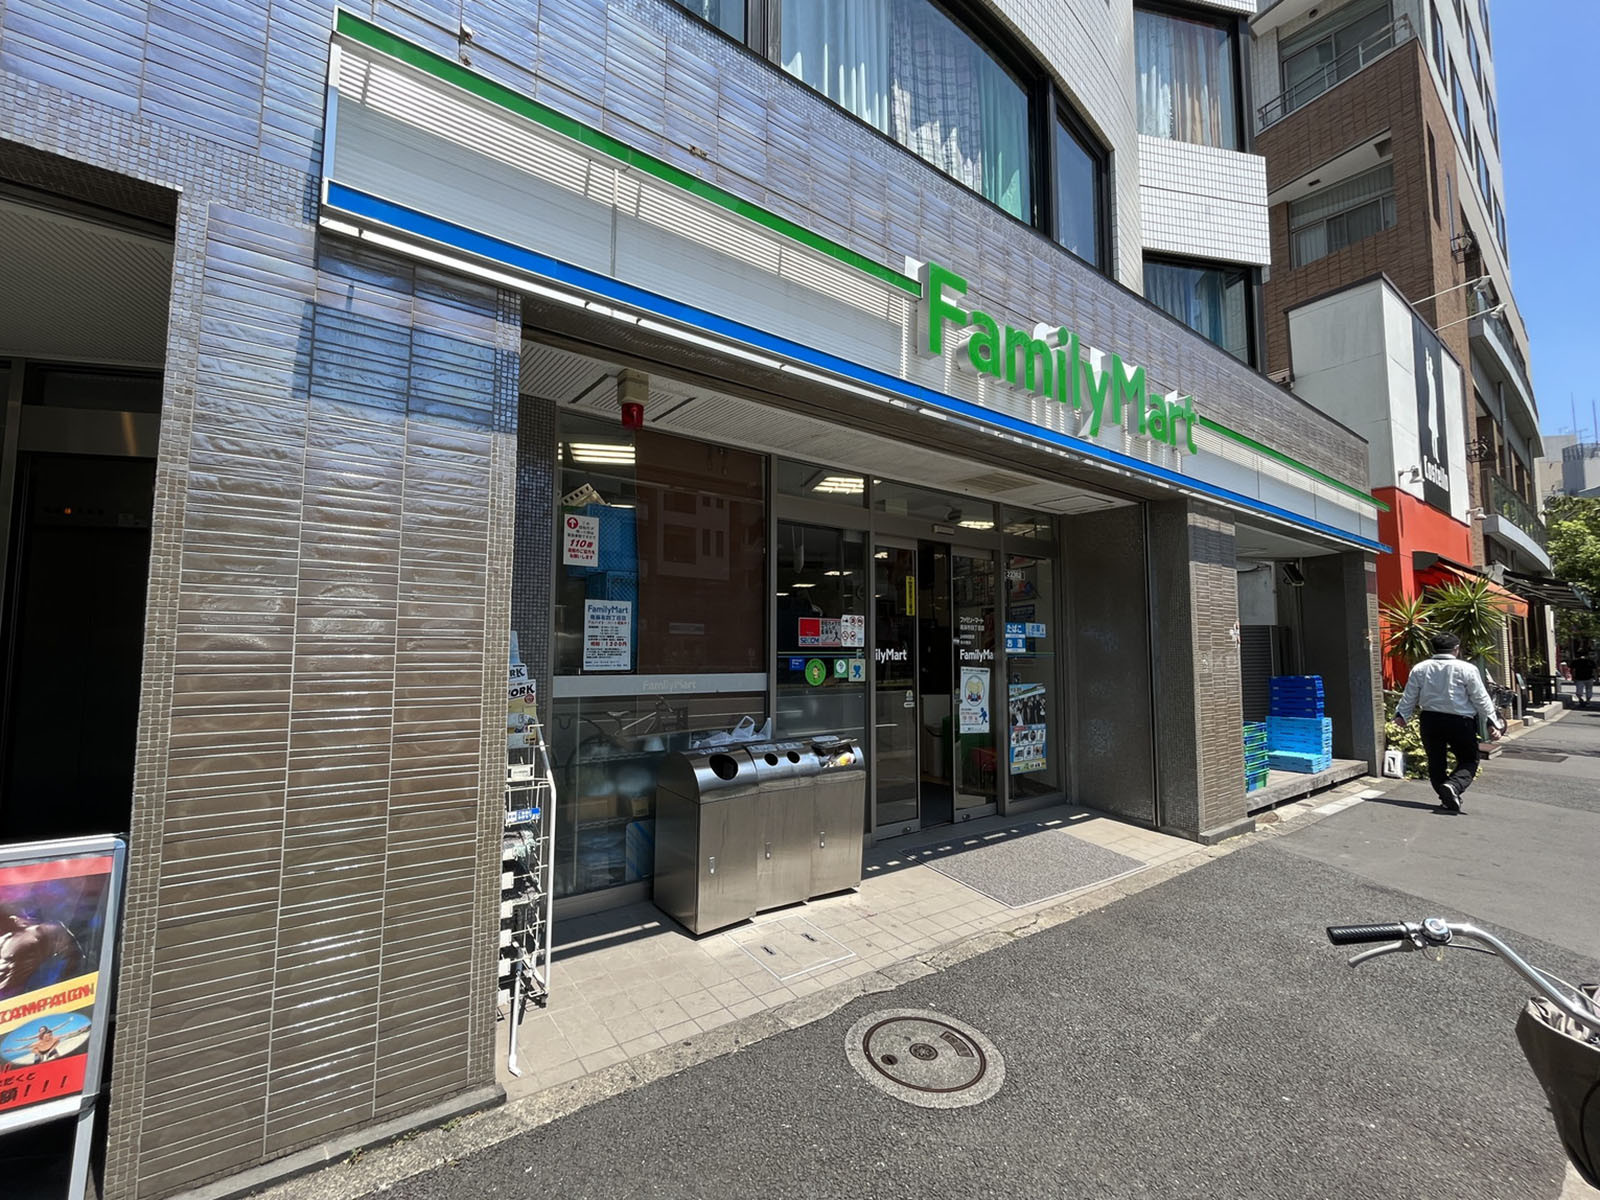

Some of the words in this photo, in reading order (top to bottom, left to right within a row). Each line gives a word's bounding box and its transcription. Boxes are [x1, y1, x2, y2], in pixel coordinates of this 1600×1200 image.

[927, 260, 1199, 455] FamilyMart
[588, 604, 629, 615] FamilyMart
[508, 683, 536, 697] ORK
